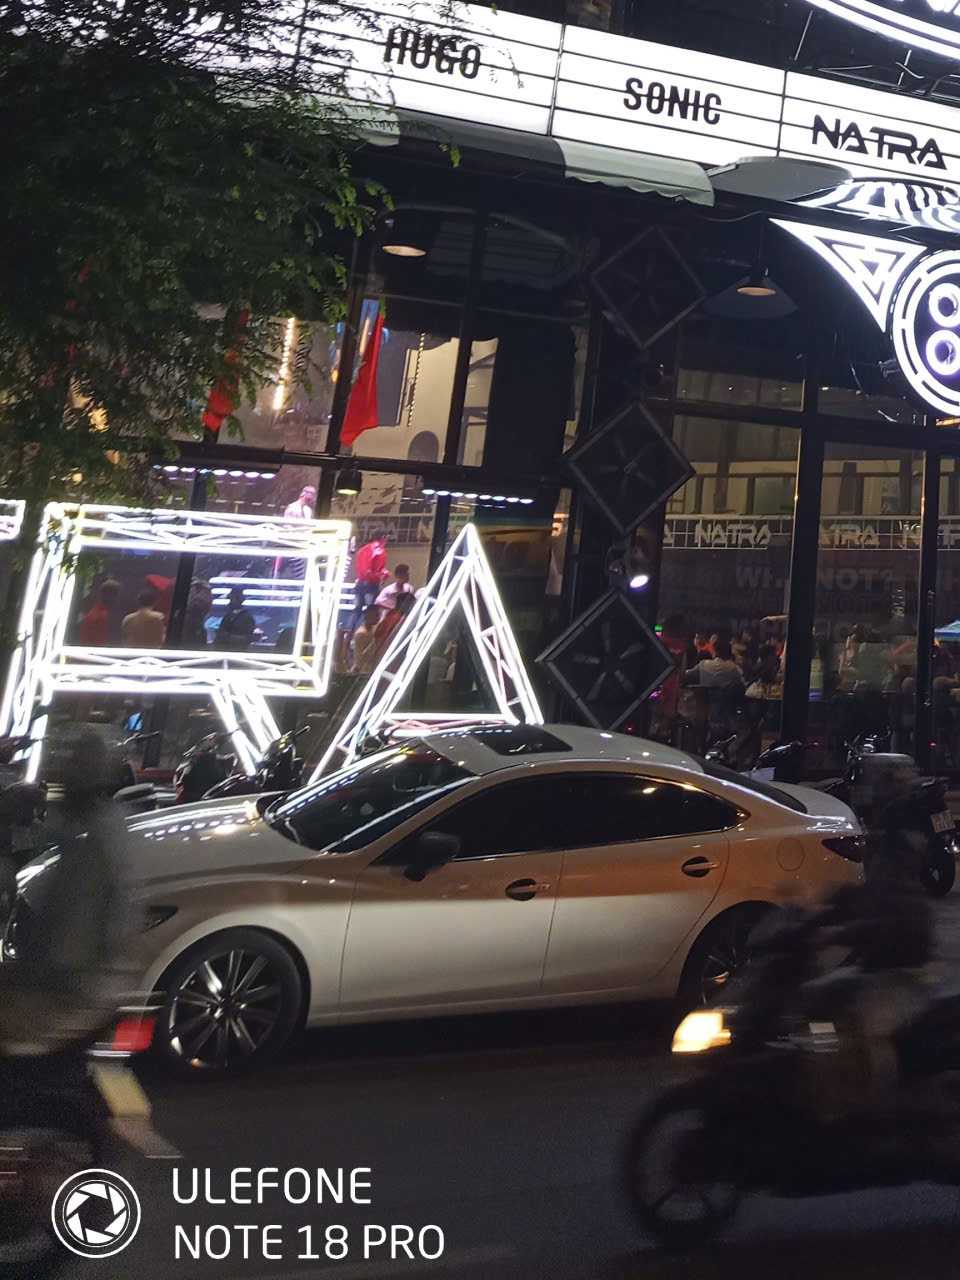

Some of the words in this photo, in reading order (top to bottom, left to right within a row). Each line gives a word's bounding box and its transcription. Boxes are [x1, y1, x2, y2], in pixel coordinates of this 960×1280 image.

[383, 28, 481, 80] HUGO
[623, 77, 722, 125] SONIC
[811, 113, 948, 170] NATRA
